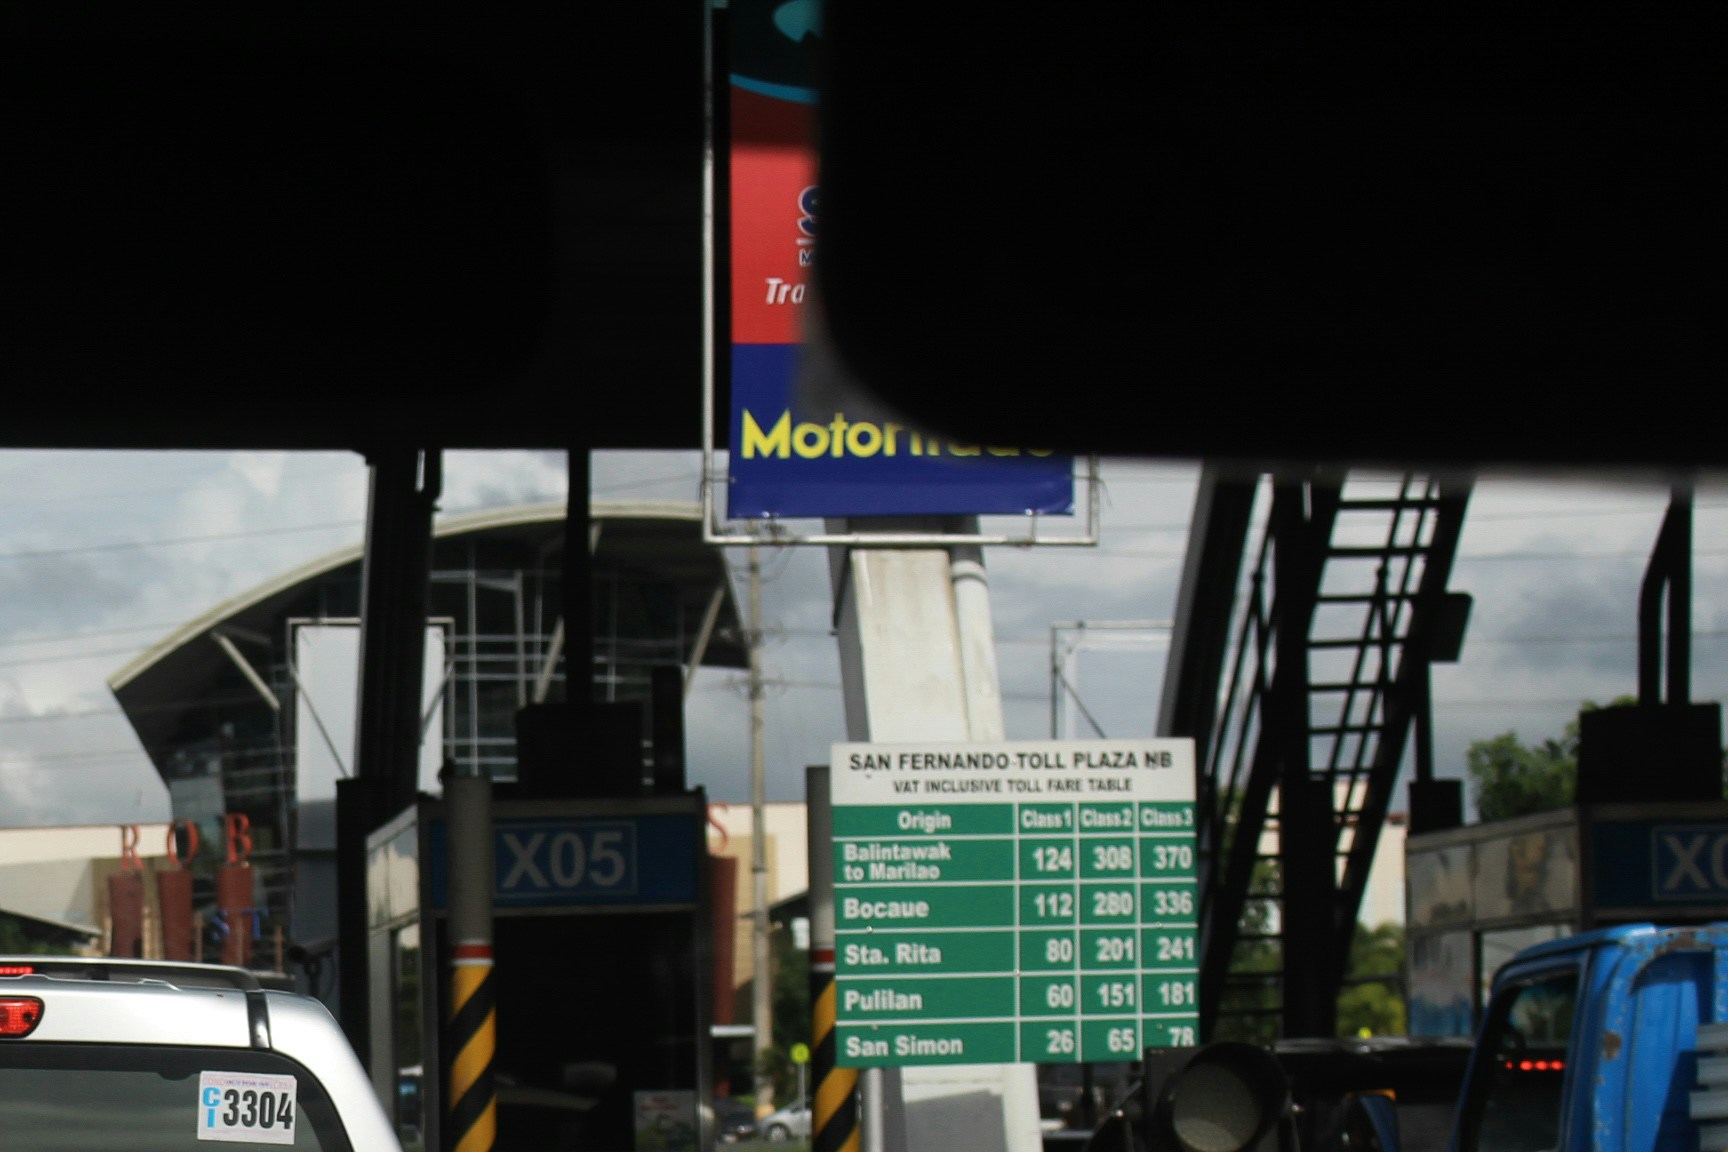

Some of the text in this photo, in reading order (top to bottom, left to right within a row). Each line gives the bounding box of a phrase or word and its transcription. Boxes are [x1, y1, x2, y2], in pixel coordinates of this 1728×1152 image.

[851, 752, 1171, 770] SAN FERNANDO TOLL PLAZA NB
[895, 779, 1130, 792] VAT INCLUSIVE TOLL FARE TABLE
[898, 811, 951, 833] Origin
[501, 831, 626, 889] X05
[845, 842, 950, 861] Balintawak
[1035, 848, 1072, 871] 124
[1095, 846, 1132, 869] 308
[1155, 846, 1192, 869] 370
[845, 863, 940, 880] to Marilao
[845, 898, 929, 918] Bocaue
[1036, 893, 1072, 916] 112
[1095, 892, 1133, 915] 280
[1155, 892, 1192, 914] 336
[846, 944, 941, 965] Sta. Rita
[1047, 939, 1072, 962] 80
[1098, 938, 1133, 961] 201
[1159, 937, 1193, 960] 241
[846, 990, 922, 1010] Pulilan
[1048, 985, 1073, 1007] 60
[1099, 984, 1134, 1006] 151
[1160, 983, 1194, 1005] 181
[847, 1036, 963, 1057] San Simon
[1048, 1030, 1074, 1053] 26
[1109, 1029, 1134, 1051] 65
[1170, 1027, 1194, 1047] 78
[223, 1088, 293, 1130] 3304
